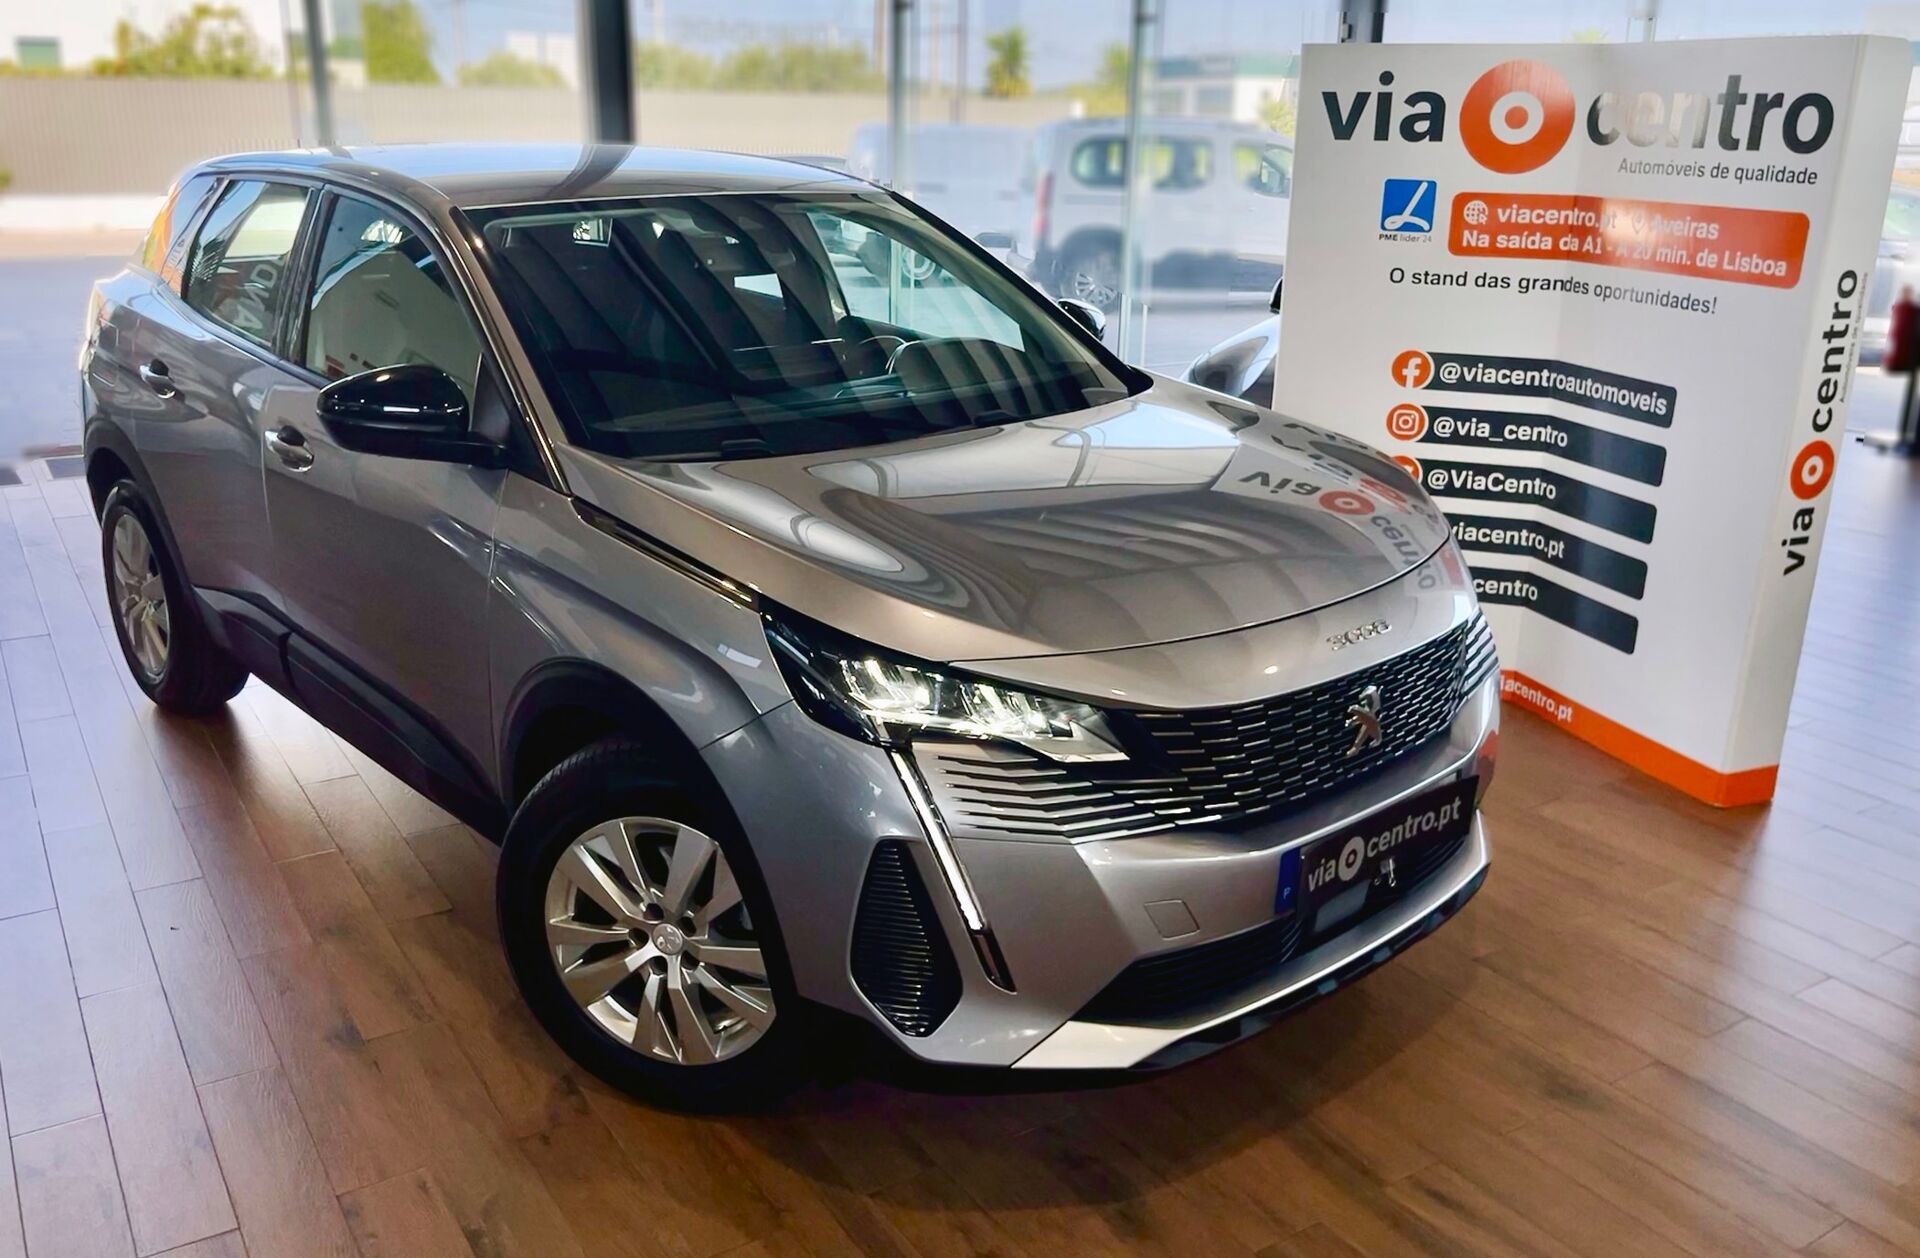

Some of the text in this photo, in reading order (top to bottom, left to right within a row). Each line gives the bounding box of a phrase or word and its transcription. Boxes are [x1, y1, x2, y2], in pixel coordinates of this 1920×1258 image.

[1322, 70, 1835, 155] via centro
[1617, 157, 1819, 185] Automóveis de qualidade
[1378, 233, 1399, 242] PME
[1497, 203, 1720, 240] viacentro.pt Aveiras
[1461, 229, 1490, 248] Na
[1495, 231, 1553, 250] saída
[1558, 233, 1579, 251] da
[1582, 235, 1603, 255] A1
[1655, 246, 1691, 266] min.
[1695, 248, 1718, 269] de
[1722, 252, 1788, 278] Lisboa
[1389, 267, 1717, 315] O stand das grandes oportunidades!
[1438, 361, 1668, 417] @viacentroautomoveis
[1432, 415, 1568, 448] @via_centro
[1782, 506, 1816, 577] via
[1811, 269, 1858, 433] centro
[1426, 468, 1557, 500] @ViaCentro
[1307, 796, 1462, 892] via centro.pt
